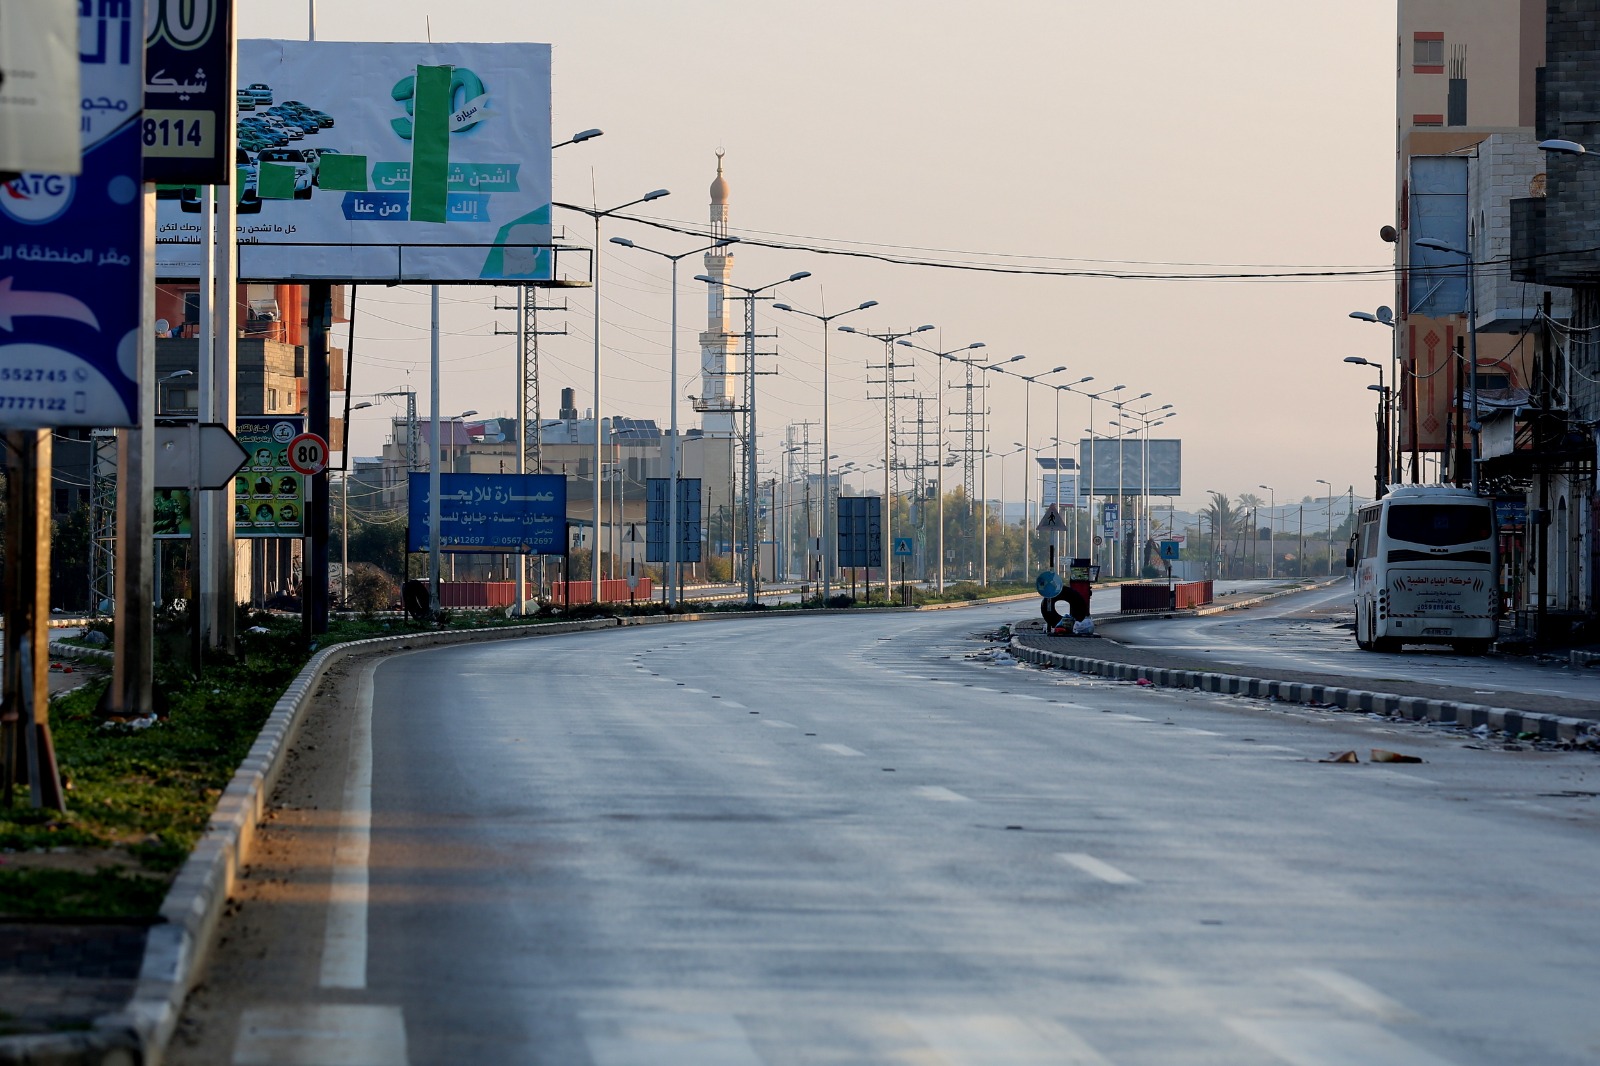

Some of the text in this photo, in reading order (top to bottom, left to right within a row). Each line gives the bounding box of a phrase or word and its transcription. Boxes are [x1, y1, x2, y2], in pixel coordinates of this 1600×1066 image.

[146, 68, 208, 101] شيك
[456, 106, 478, 123] سيارة
[469, 167, 511, 187] اشحن
[353, 199, 478, 220] إلك من عنا
[159, 222, 178, 233] لتكن
[247, 223, 272, 234] تشحن
[273, 224, 283, 233] ما
[284, 224, 297, 235] كل
[16, 243, 93, 265] المنطقة
[98, 247, 131, 267] مقر
[297, 446, 318, 462] 80
[422, 486, 555, 506] عمارة للإيجر
[460, 511, 487, 525] طابق
[493, 511, 516, 522] سدة
[522, 511, 554, 525] مخازن
[523, 537, 553, 545] 412697
[1449, 576, 1472, 586] شركة
